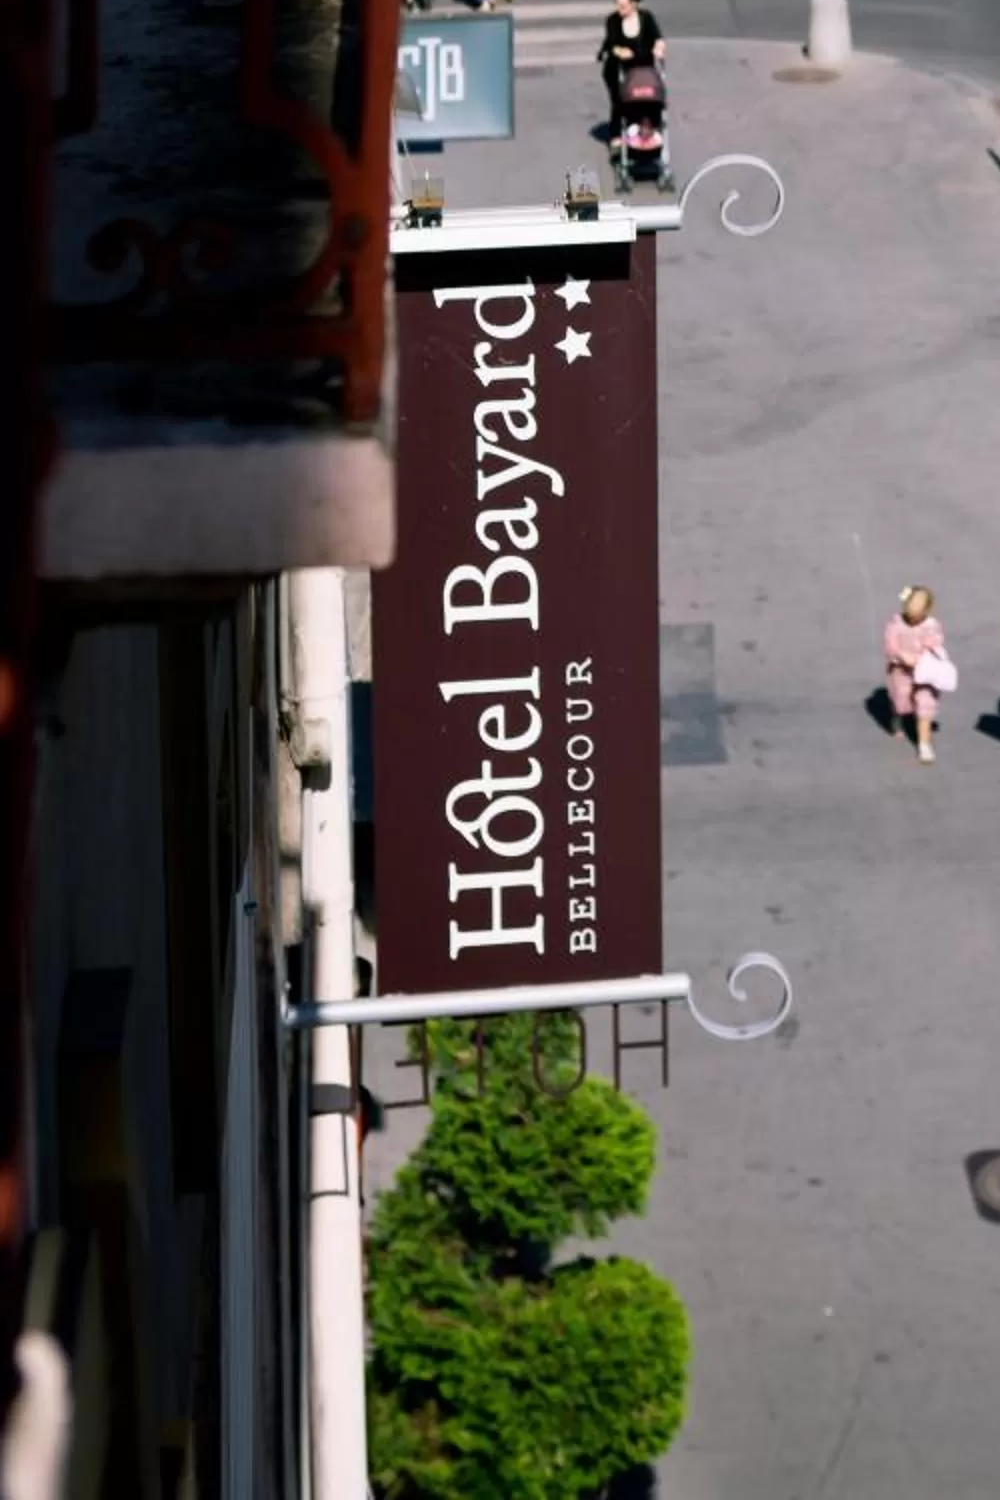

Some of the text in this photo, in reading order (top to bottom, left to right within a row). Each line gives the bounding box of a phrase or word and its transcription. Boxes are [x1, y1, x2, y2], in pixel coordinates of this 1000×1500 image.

[432, 276, 565, 961] Hôtel Bayard
[565, 656, 597, 954] BELLECOUR
